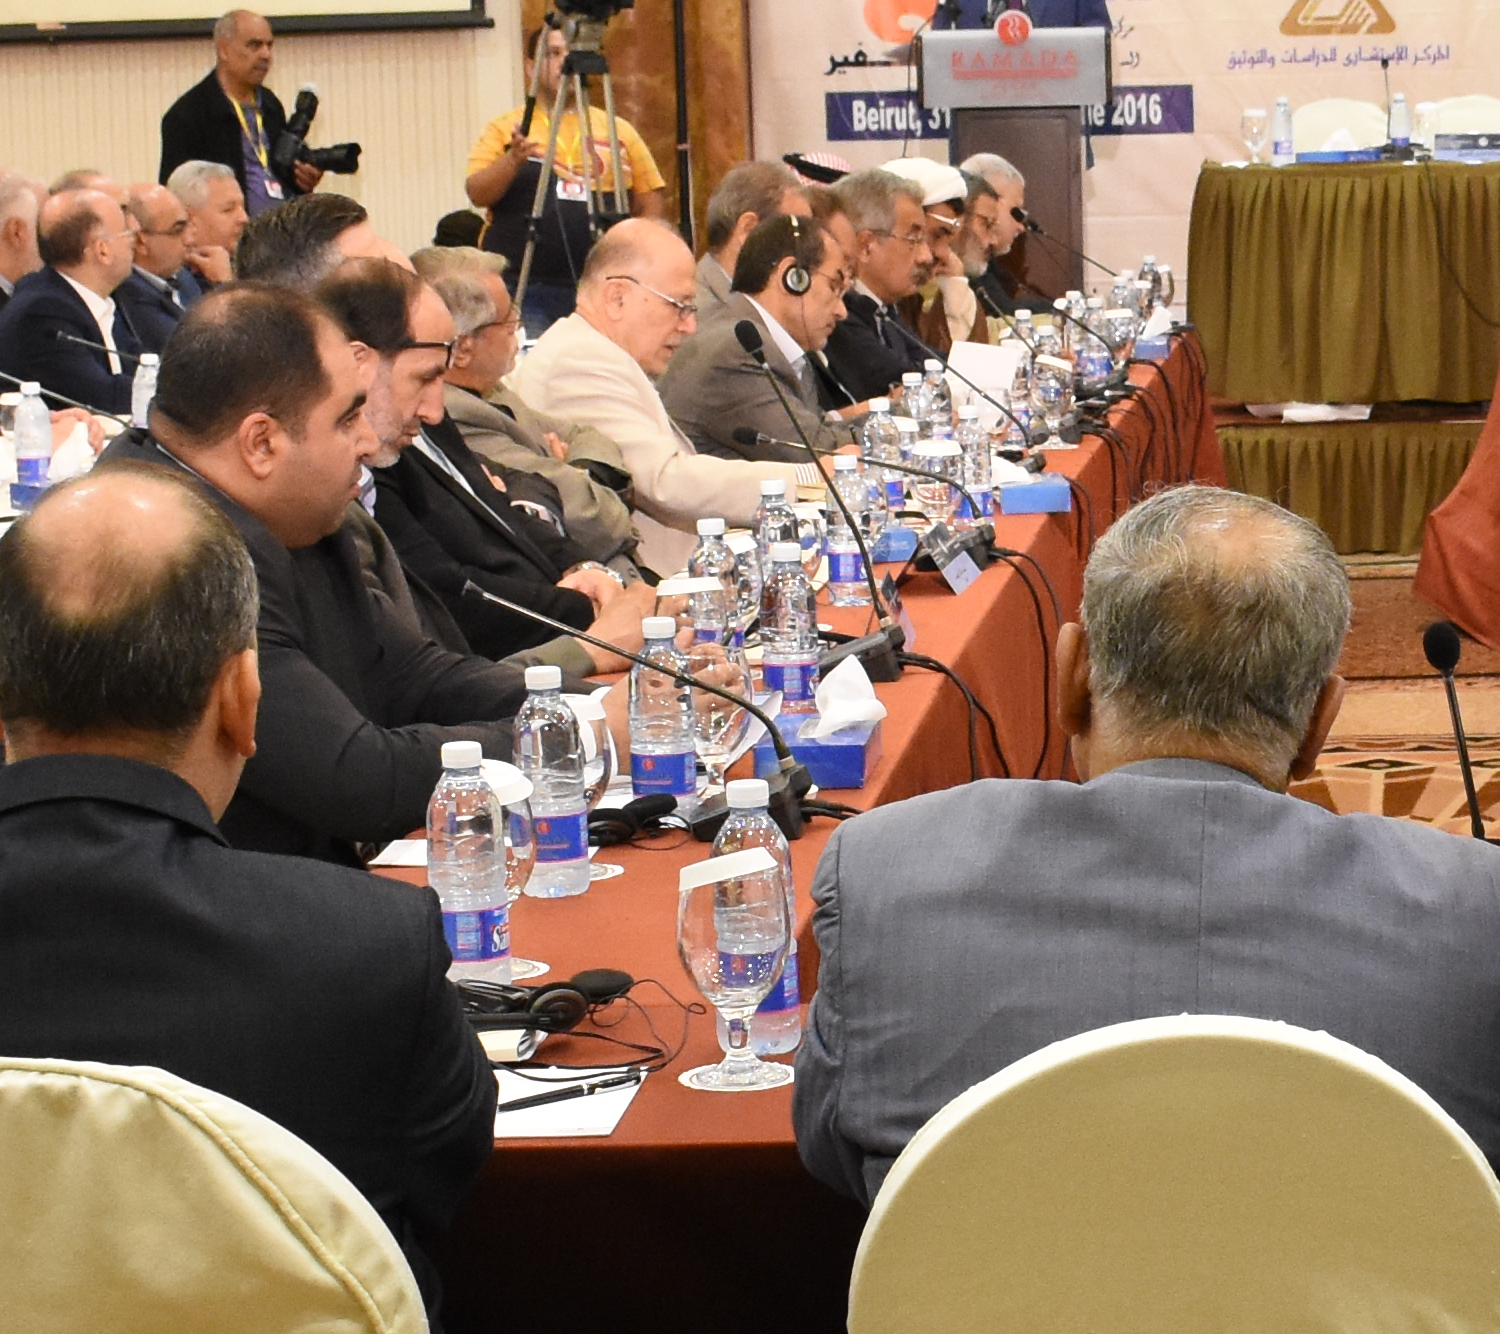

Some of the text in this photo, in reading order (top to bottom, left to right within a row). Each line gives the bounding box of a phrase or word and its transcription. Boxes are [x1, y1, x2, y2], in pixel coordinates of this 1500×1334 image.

[852, 99, 922, 137] Beirut,
[927, 104, 950, 130] 31
[1111, 92, 1164, 127] 2016
